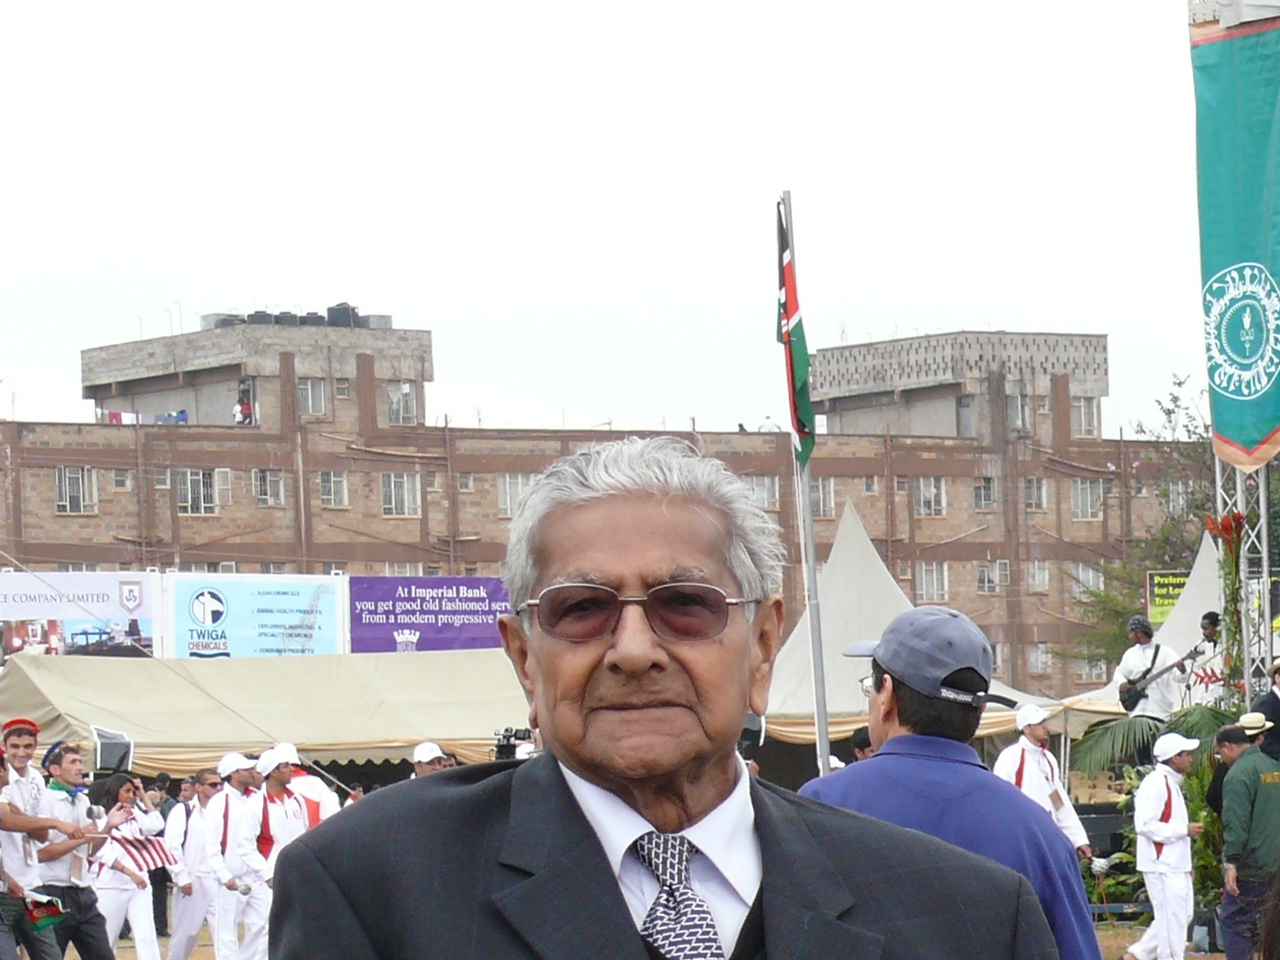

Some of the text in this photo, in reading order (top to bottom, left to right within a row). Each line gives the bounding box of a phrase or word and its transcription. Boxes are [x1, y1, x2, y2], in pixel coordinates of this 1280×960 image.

[395, 585, 487, 600] At Imperial Bank
[1154, 586, 1167, 594] for
[12, 593, 64, 603] COMPANY
[66, 593, 110, 603] LIMITED
[355, 601, 375, 613] you
[377, 600, 393, 613] get
[395, 599, 421, 613] good
[423, 599, 439, 611] old
[442, 598, 489, 611] fashioned
[362, 612, 386, 624] from
[388, 615, 395, 624] a
[397, 612, 435, 624] modern
[437, 611, 494, 627] progressive
[188, 629, 228, 641] TWIGA
[188, 641, 228, 651] CHEMICALS
